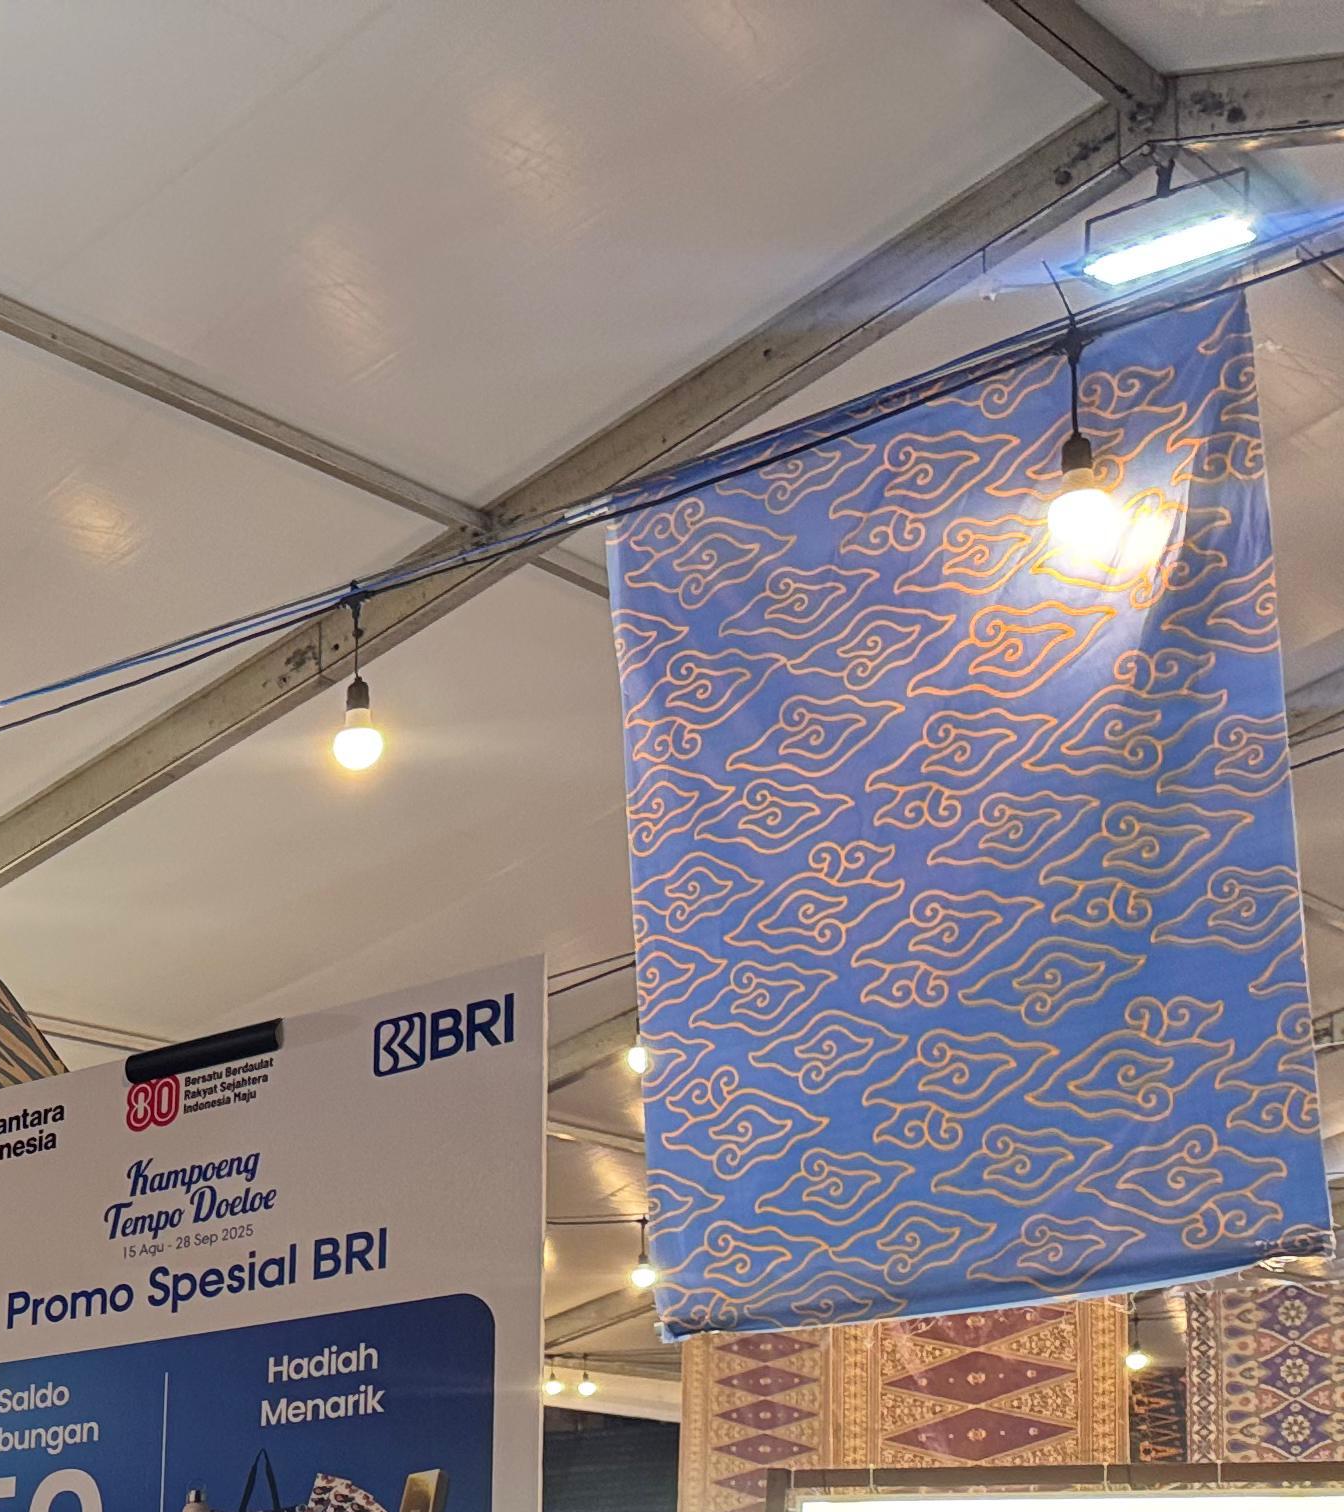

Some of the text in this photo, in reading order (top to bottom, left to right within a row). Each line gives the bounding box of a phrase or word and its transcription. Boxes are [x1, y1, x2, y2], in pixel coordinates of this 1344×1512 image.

[430, 993, 514, 1060] BRI
[184, 1057, 274, 1087] Bersatu Berdaulat
[184, 1074, 269, 1101] Rakyat Sejahtera
[126, 1074, 180, 1132] 80
[184, 1089, 257, 1114] Indonesia Maju
[126, 1152, 261, 1197] Kampoeng
[104, 1185, 277, 1240] Tempo Doeloe
[123, 1244, 136, 1259] 15
[141, 1243, 165, 1257] Agu
[176, 1235, 191, 1250] 28
[194, 1233, 218, 1247] Sep
[222, 1224, 254, 1241] 2025
[6, 1228, 387, 1330] Promo Spesial BRI
[267, 1343, 378, 1384] Hadiah
[260, 1385, 385, 1427] Menarik
